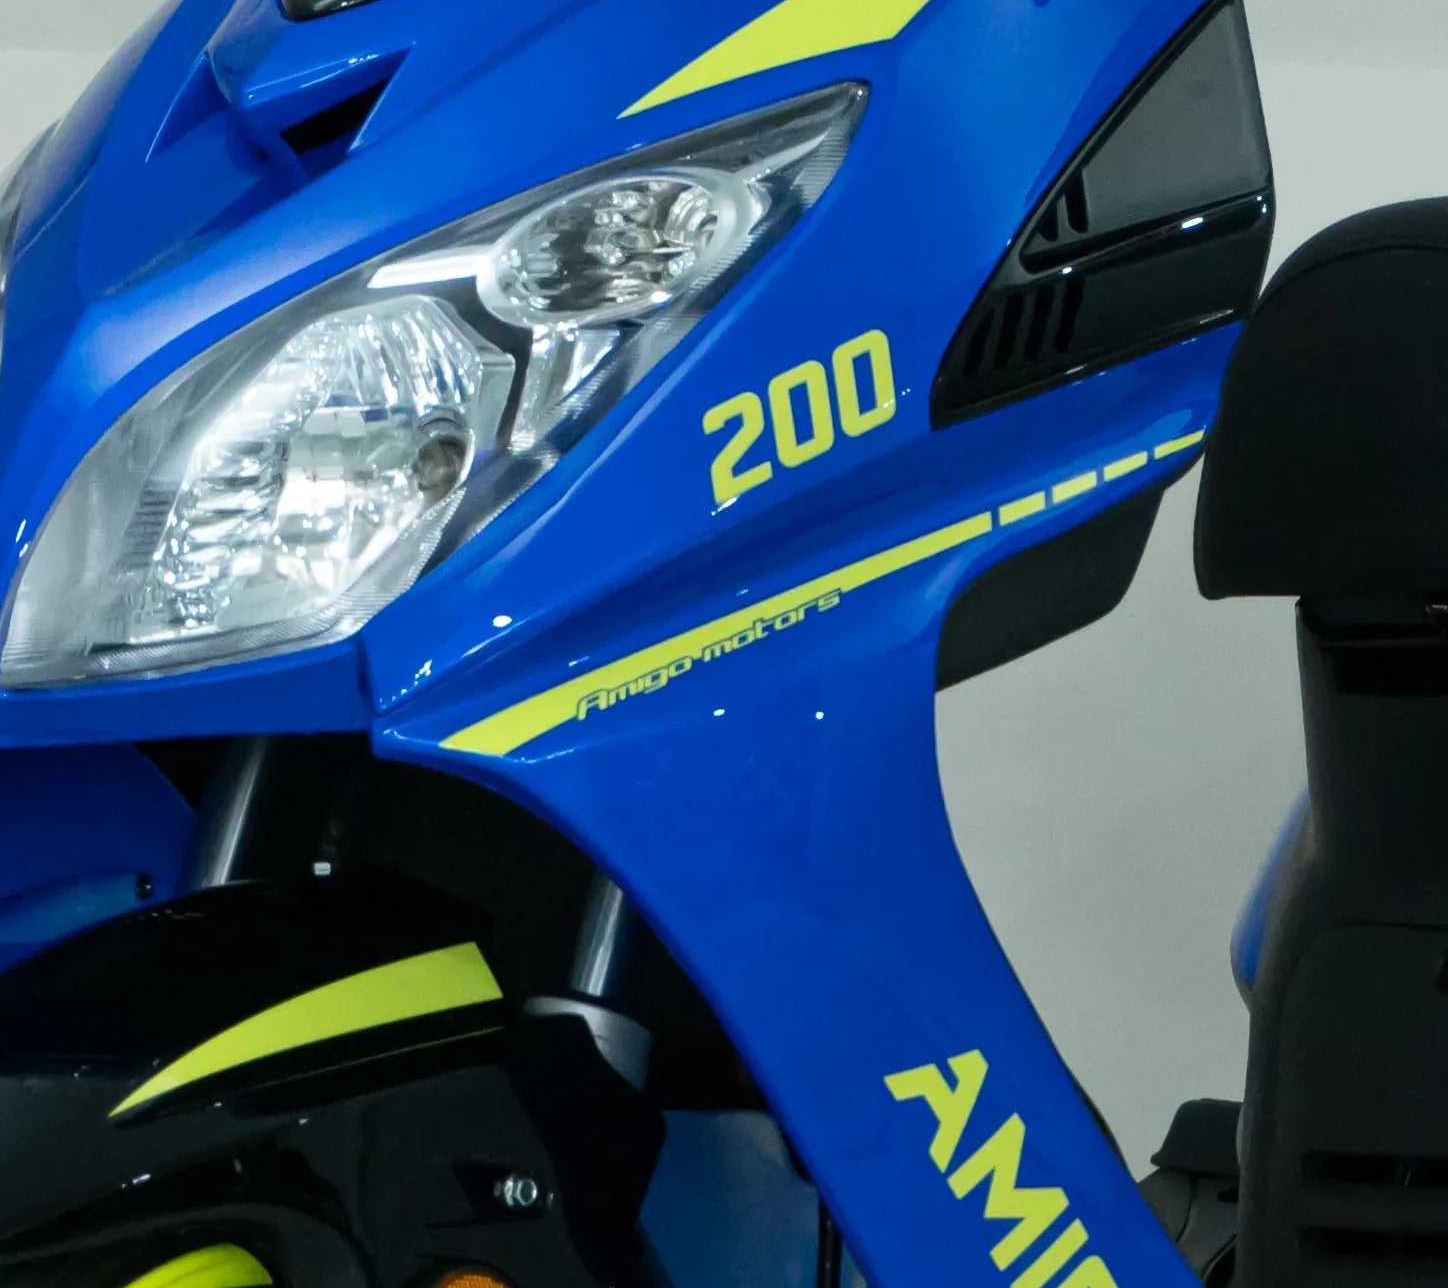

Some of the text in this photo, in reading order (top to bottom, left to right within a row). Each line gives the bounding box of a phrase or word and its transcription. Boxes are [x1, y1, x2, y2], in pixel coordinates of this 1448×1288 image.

[704, 331, 894, 501] 200
[576, 588, 842, 721] Amigo motors
